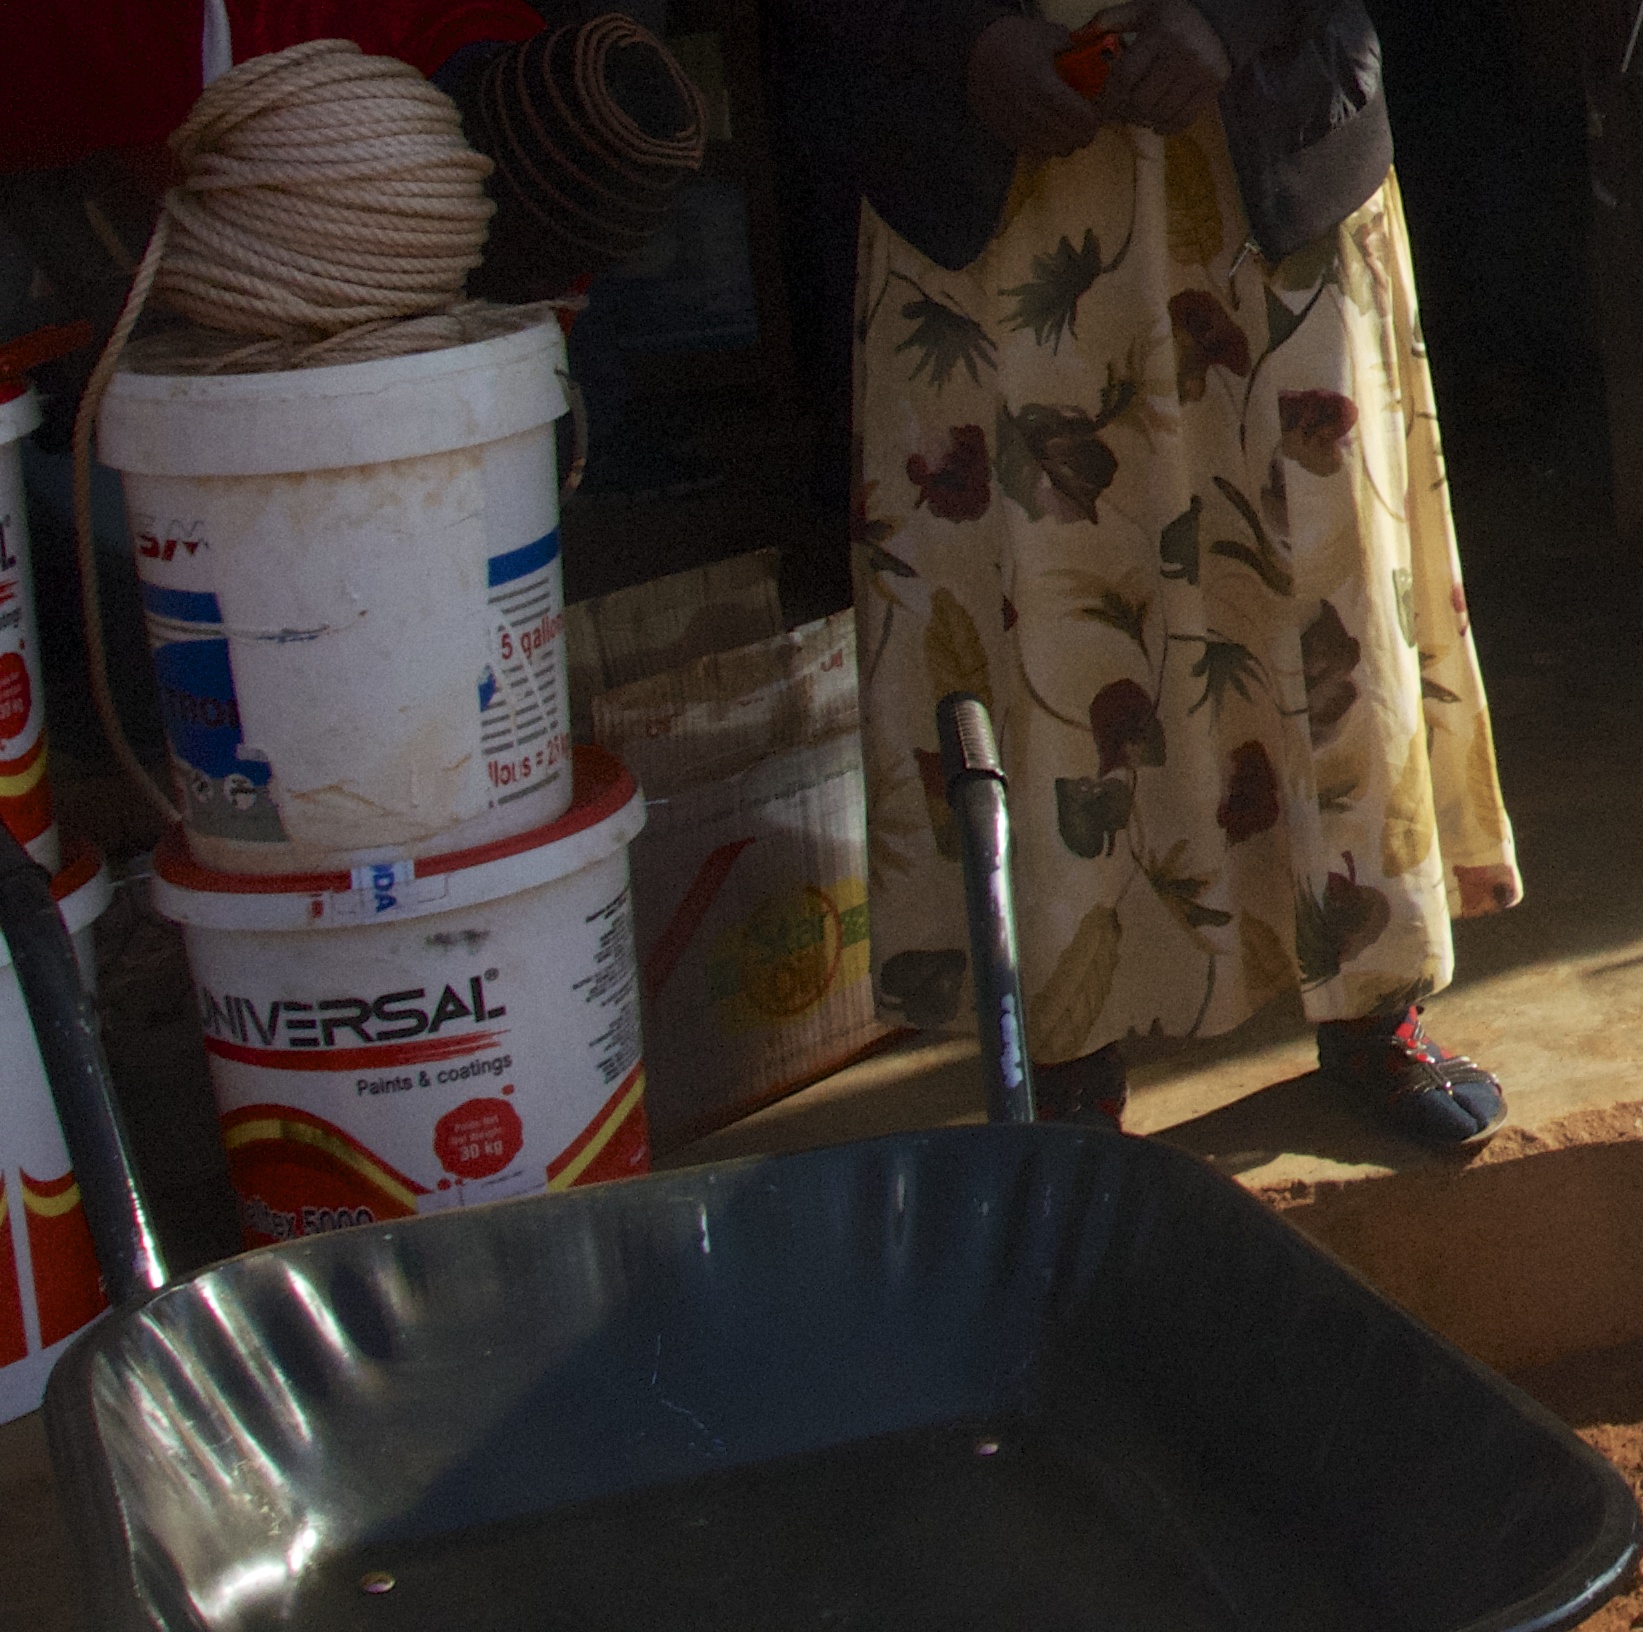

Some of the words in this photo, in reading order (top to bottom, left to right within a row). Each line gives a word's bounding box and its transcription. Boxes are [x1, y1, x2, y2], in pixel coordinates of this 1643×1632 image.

[357, 1070, 413, 1097] Paints
[419, 1070, 432, 1088] &
[437, 1053, 513, 1085] coatings
